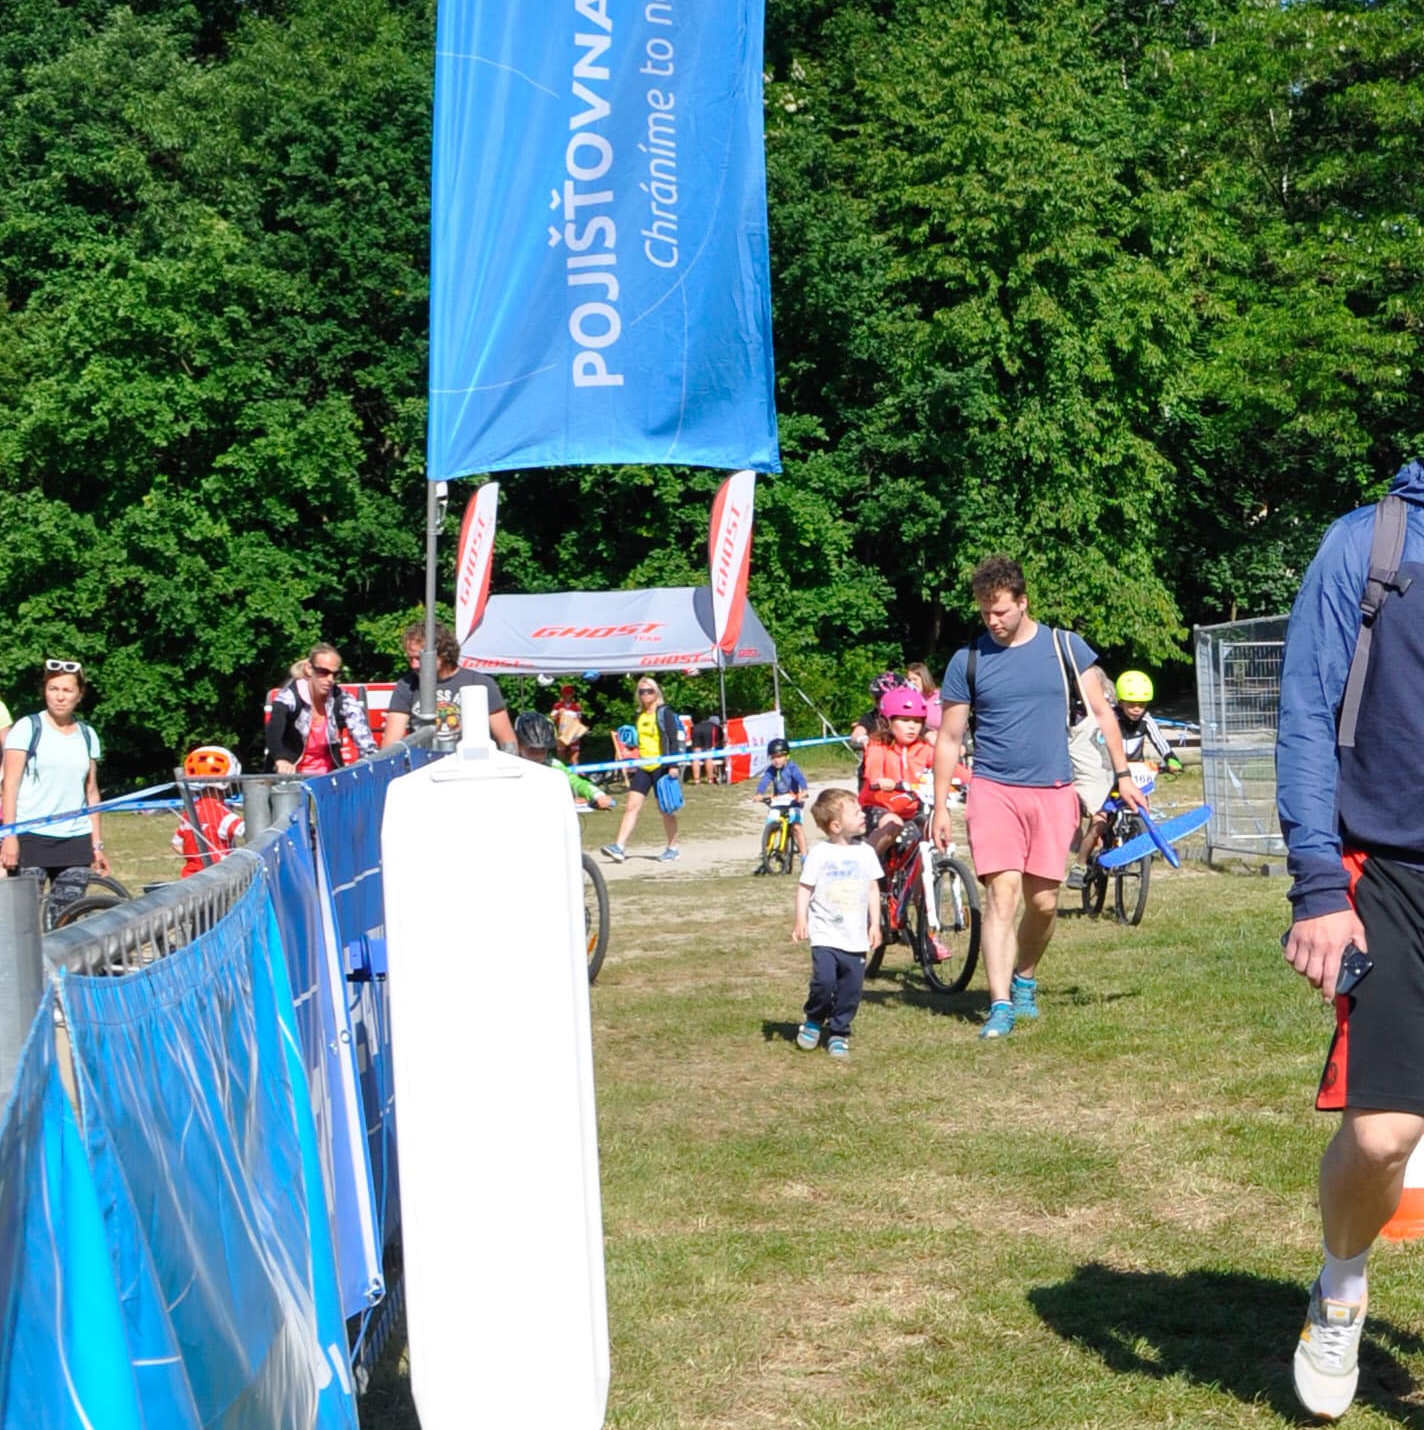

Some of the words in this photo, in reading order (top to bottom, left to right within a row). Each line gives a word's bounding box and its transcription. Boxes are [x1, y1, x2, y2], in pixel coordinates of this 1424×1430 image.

[641, 38, 674, 76] to
[639, 88, 678, 268] Chráníme
[459, 515, 486, 607] GHOST
[715, 501, 741, 597] GHOST
[530, 621, 669, 640] GHOST
[639, 651, 703, 666] GHOST
